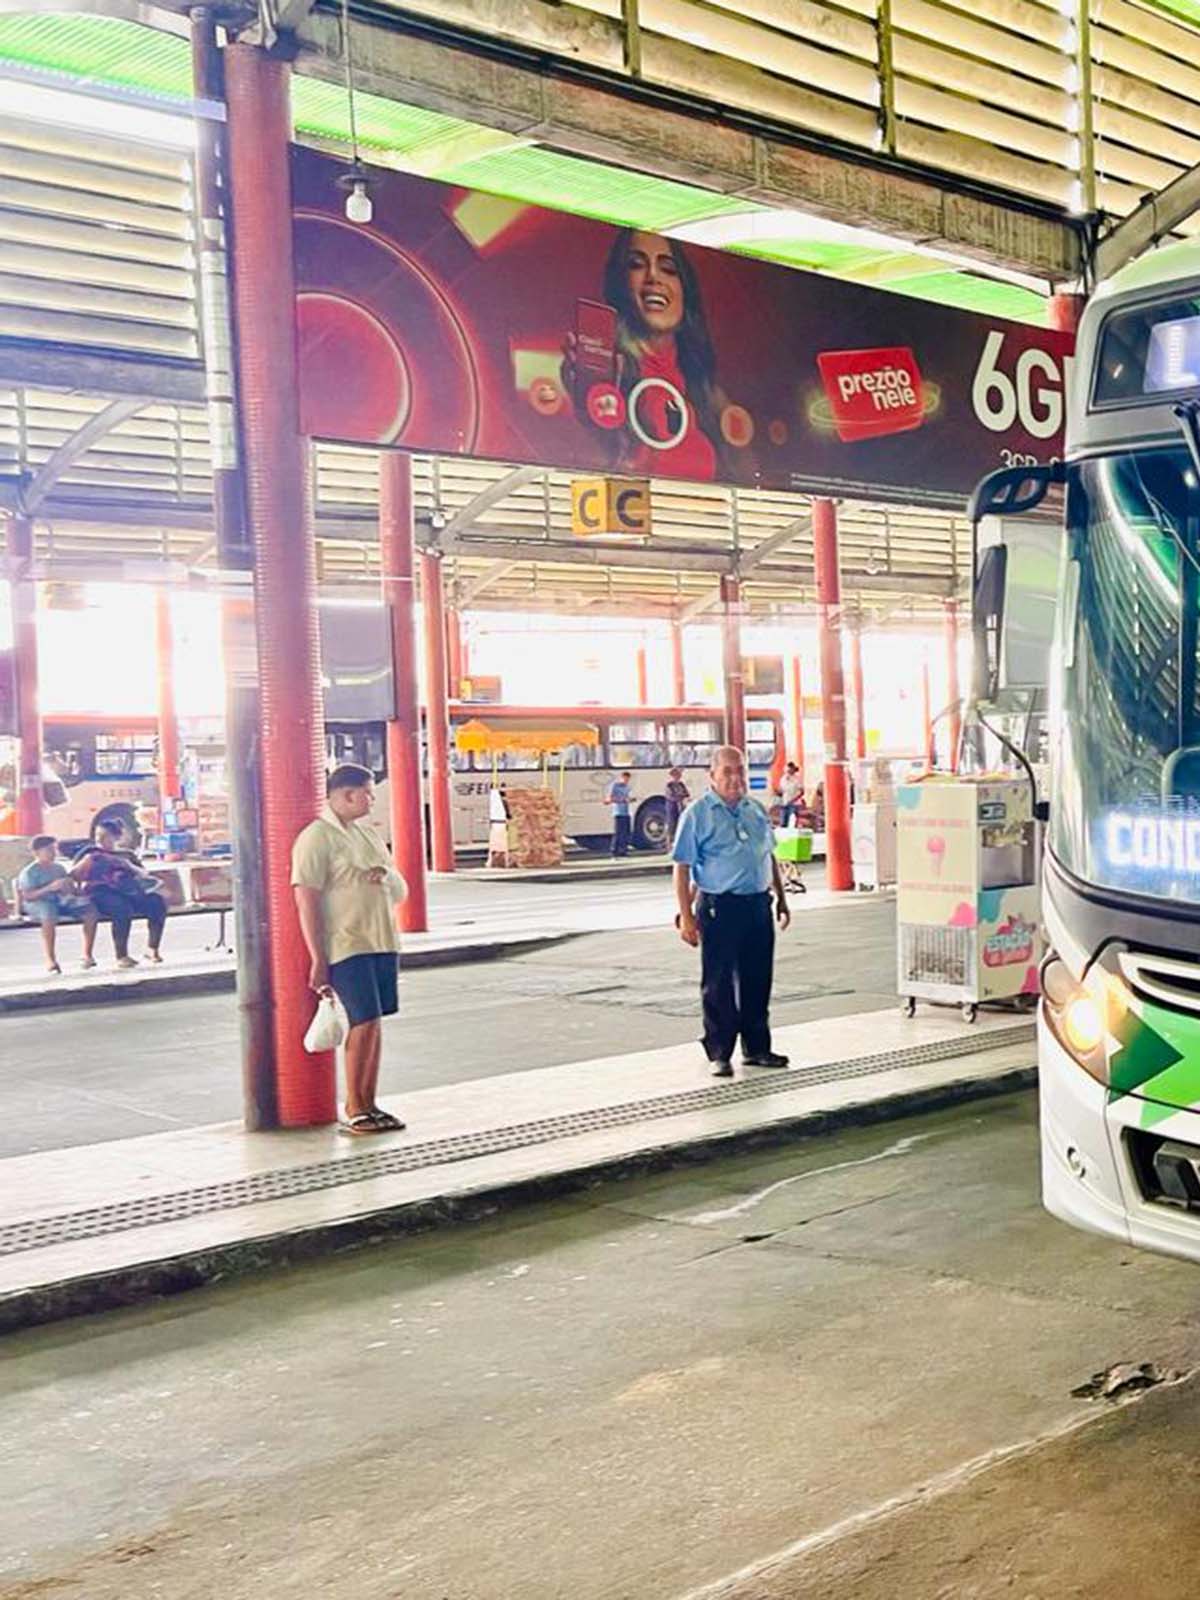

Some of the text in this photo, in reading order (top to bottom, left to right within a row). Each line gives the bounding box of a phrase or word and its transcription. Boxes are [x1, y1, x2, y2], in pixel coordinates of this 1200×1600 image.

[838, 365, 911, 403] prezão
[872, 385, 916, 412] nele
[973, 331, 1075, 439] 6G
[579, 489, 600, 528] C
[616, 489, 644, 527] C
